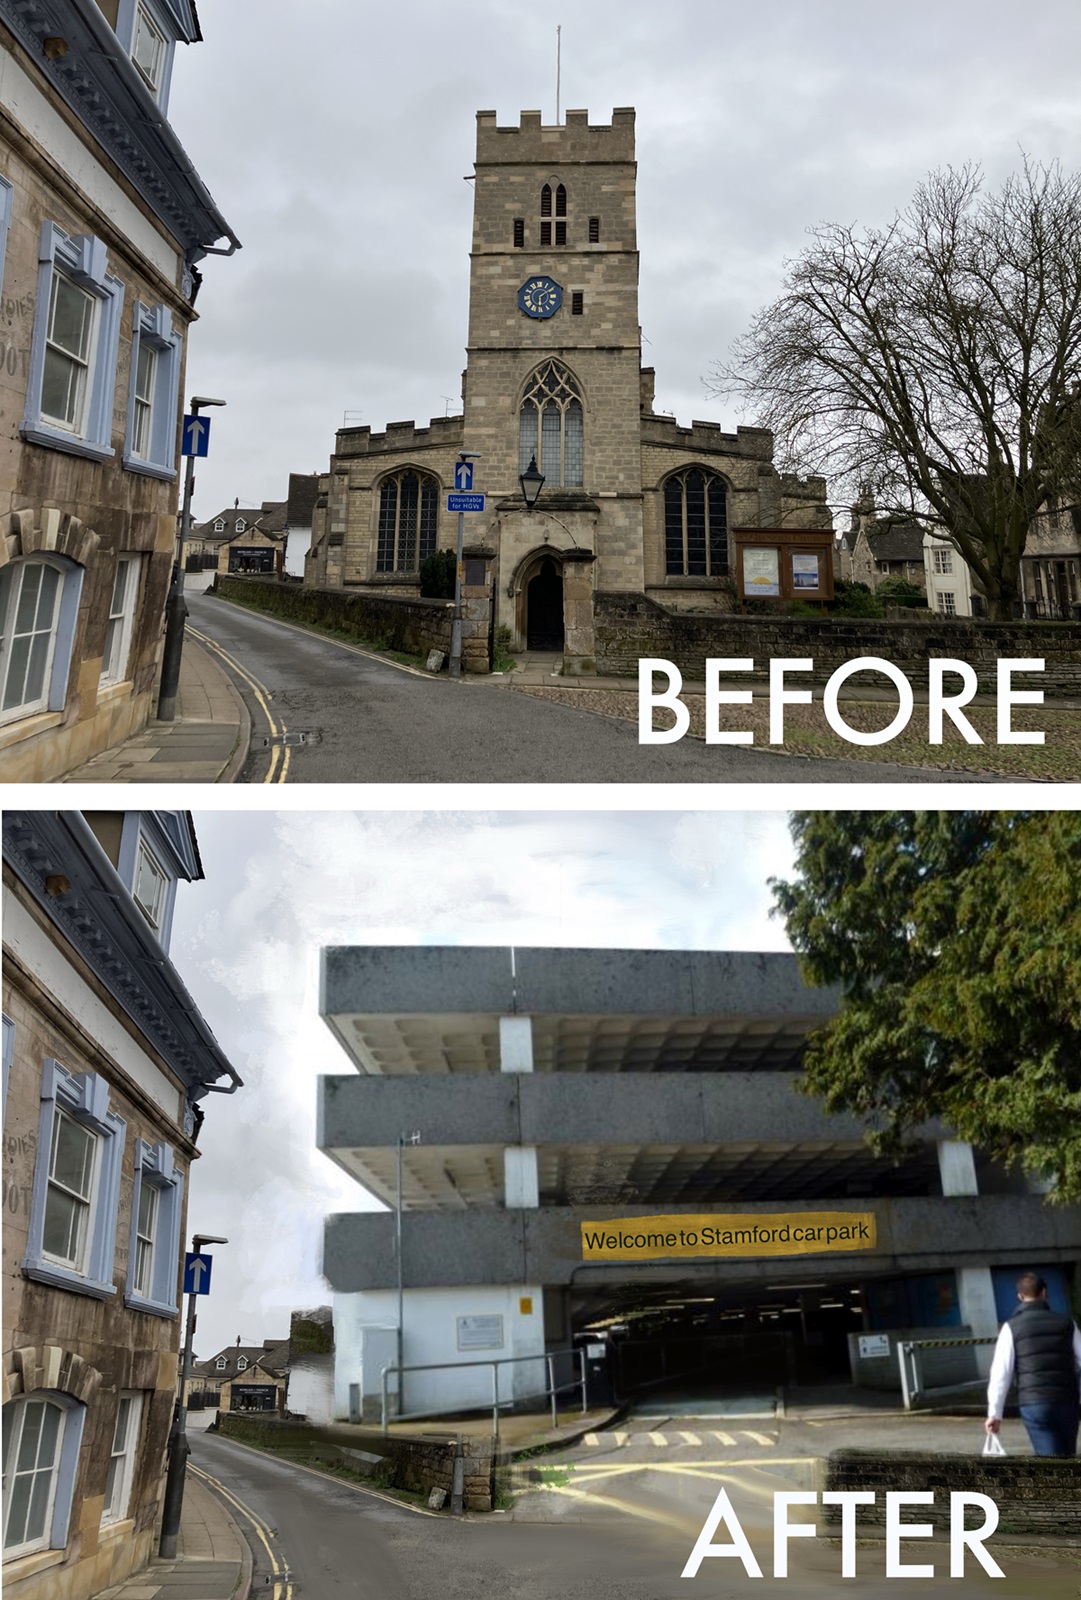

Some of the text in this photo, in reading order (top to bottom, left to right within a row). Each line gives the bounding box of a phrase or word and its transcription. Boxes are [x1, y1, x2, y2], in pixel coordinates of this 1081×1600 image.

[585, 1222, 869, 1250] Welcome to Stamford car park
